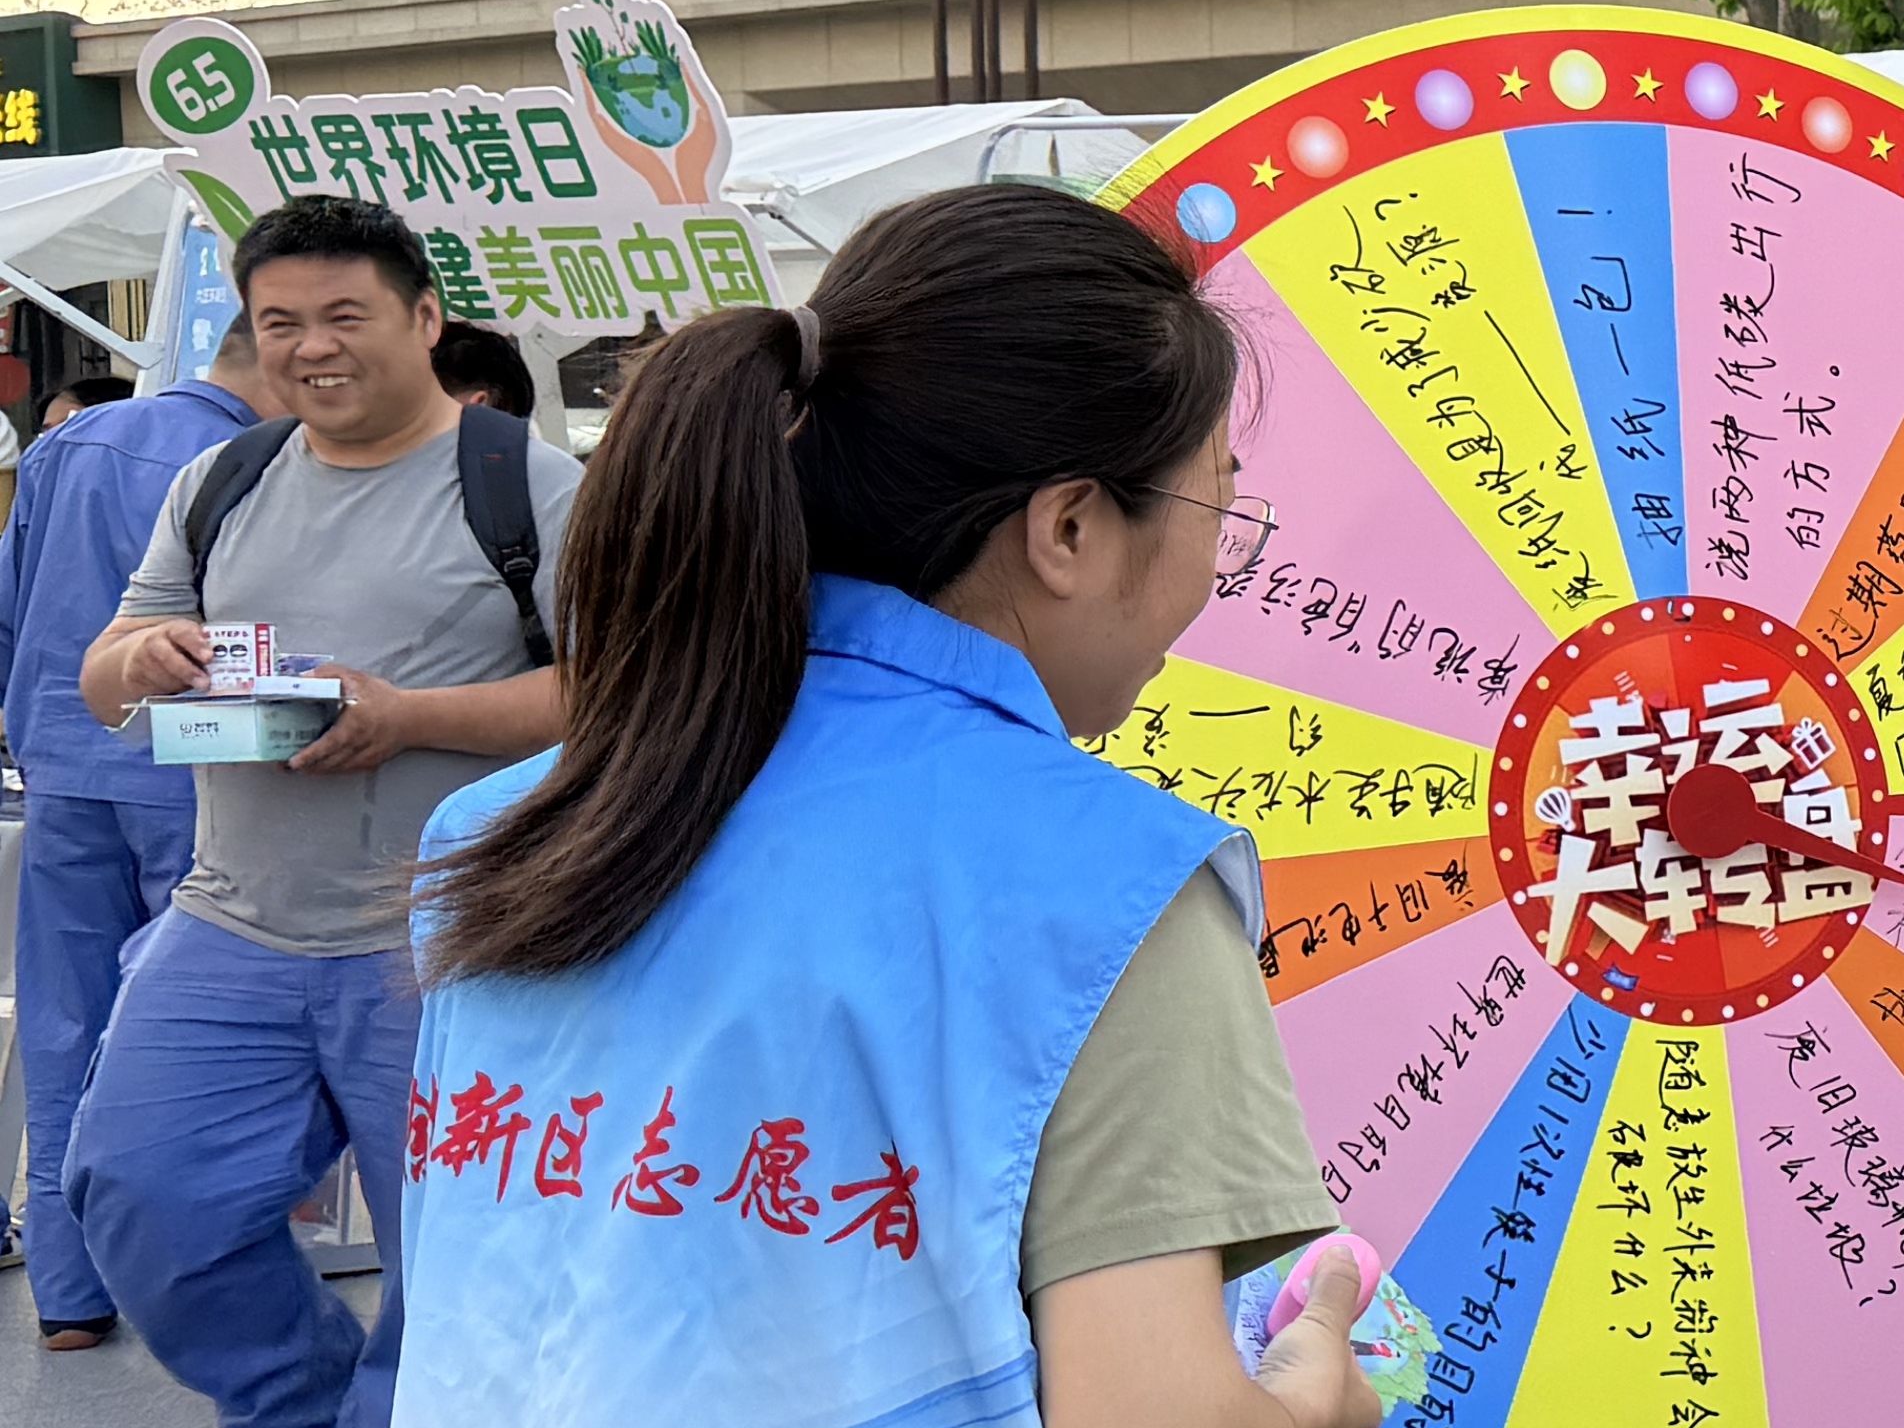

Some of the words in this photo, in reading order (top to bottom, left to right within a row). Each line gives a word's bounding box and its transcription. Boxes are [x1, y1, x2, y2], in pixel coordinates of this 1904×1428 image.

[166, 51, 237, 122] 6.5
[251, 103, 598, 207] 世界环境日
[1705, 151, 1802, 582] 说两种低碳出行
[1558, 678, 1795, 847] 幸运
[1526, 769, 1876, 967] 大转盘
